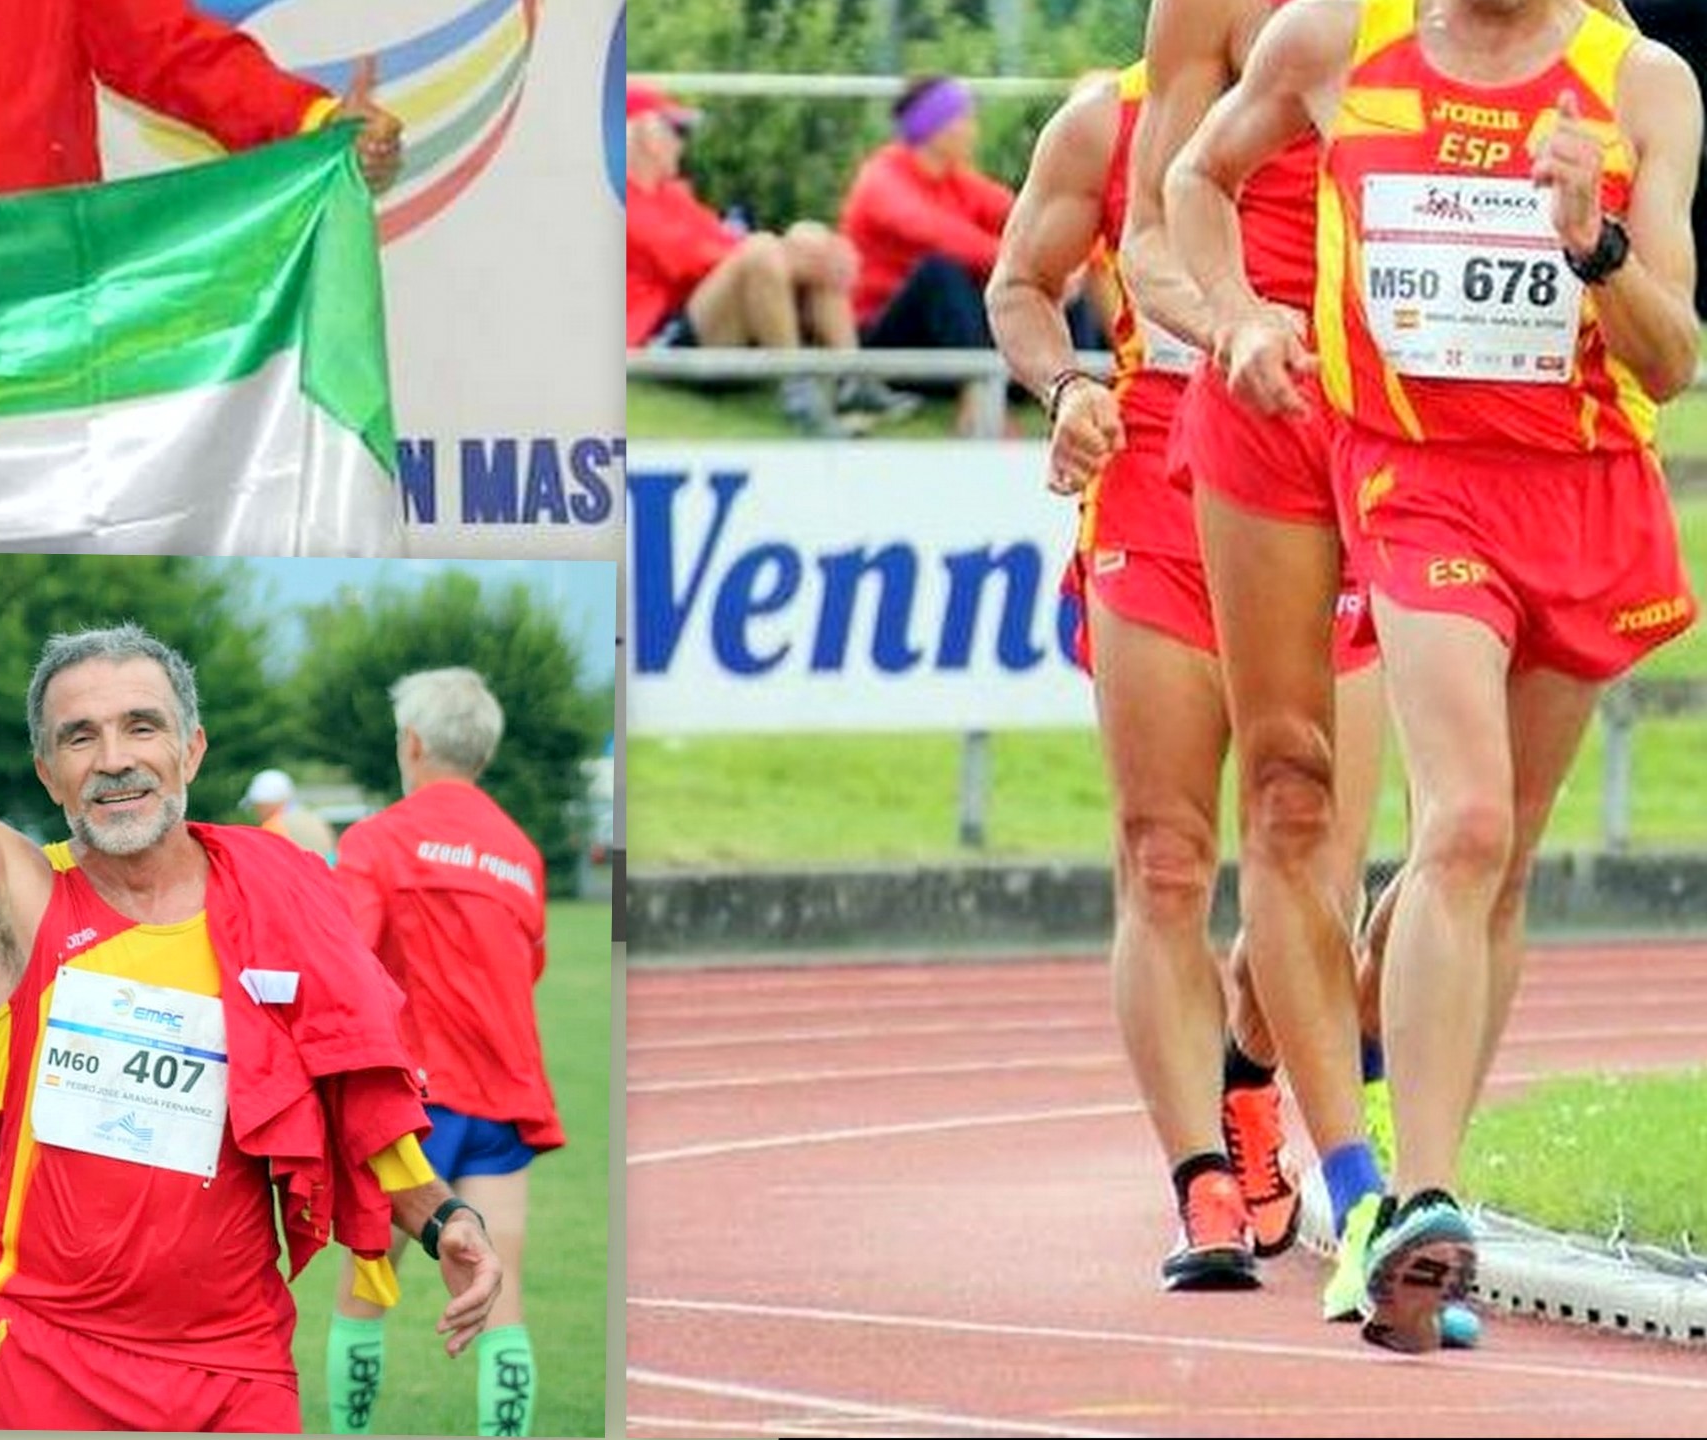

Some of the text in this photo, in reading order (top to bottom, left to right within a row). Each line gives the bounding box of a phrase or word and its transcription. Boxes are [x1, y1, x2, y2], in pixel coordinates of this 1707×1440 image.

[1434, 100, 1522, 130] Joma
[1438, 131, 1510, 170] ESP
[1369, 256, 1560, 308] M50 678
[132, 1005, 185, 1029] EMAC
[47, 1047, 206, 1094] M60 407
